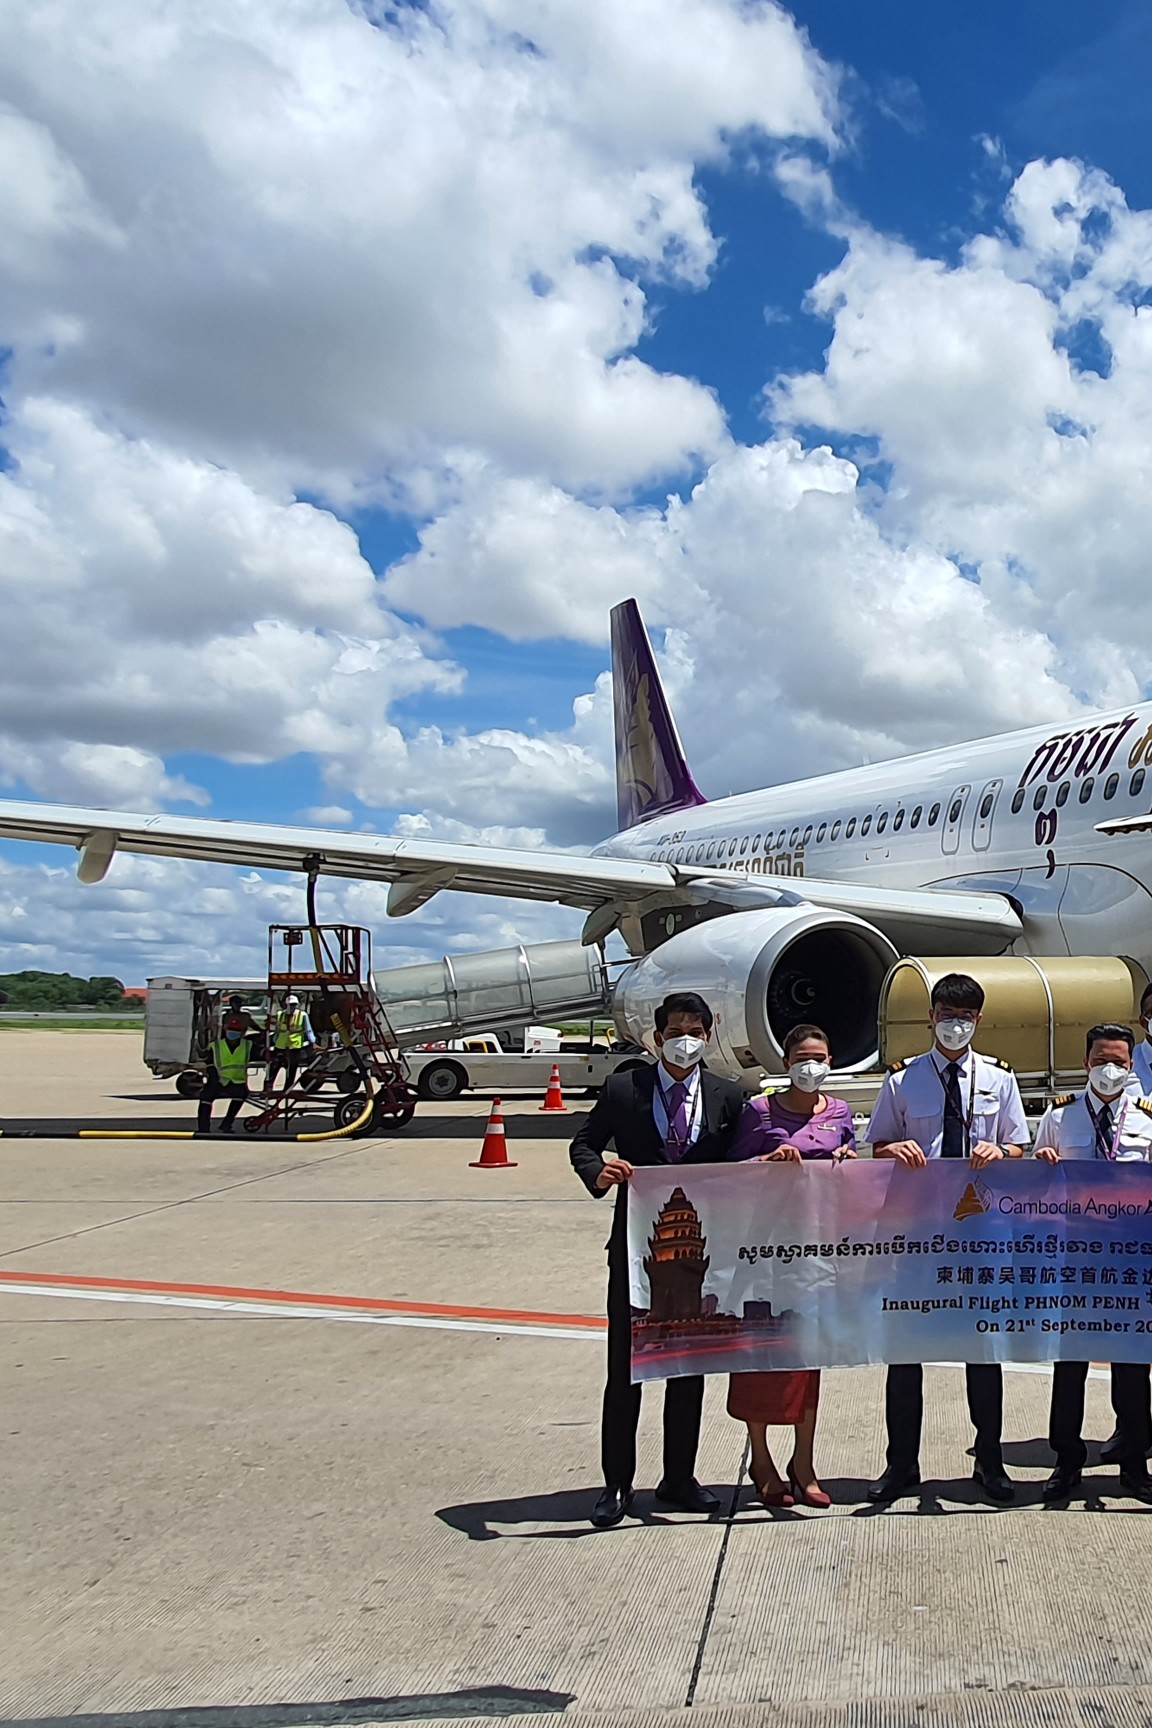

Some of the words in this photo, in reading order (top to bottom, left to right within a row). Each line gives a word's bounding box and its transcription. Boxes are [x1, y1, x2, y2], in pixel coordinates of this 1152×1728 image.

[998, 1195, 1081, 1215] Cambodia
[1084, 1197, 1143, 1219] Angkor
[881, 1295, 964, 1314] Inaugural
[968, 1295, 1019, 1314] Flight
[1023, 1294, 1087, 1311] PHNOM
[1092, 1296, 1141, 1311] PENH
[975, 1319, 1001, 1334] On
[1005, 1317, 1036, 1333] 21st
[1040, 1318, 1130, 1336] September
